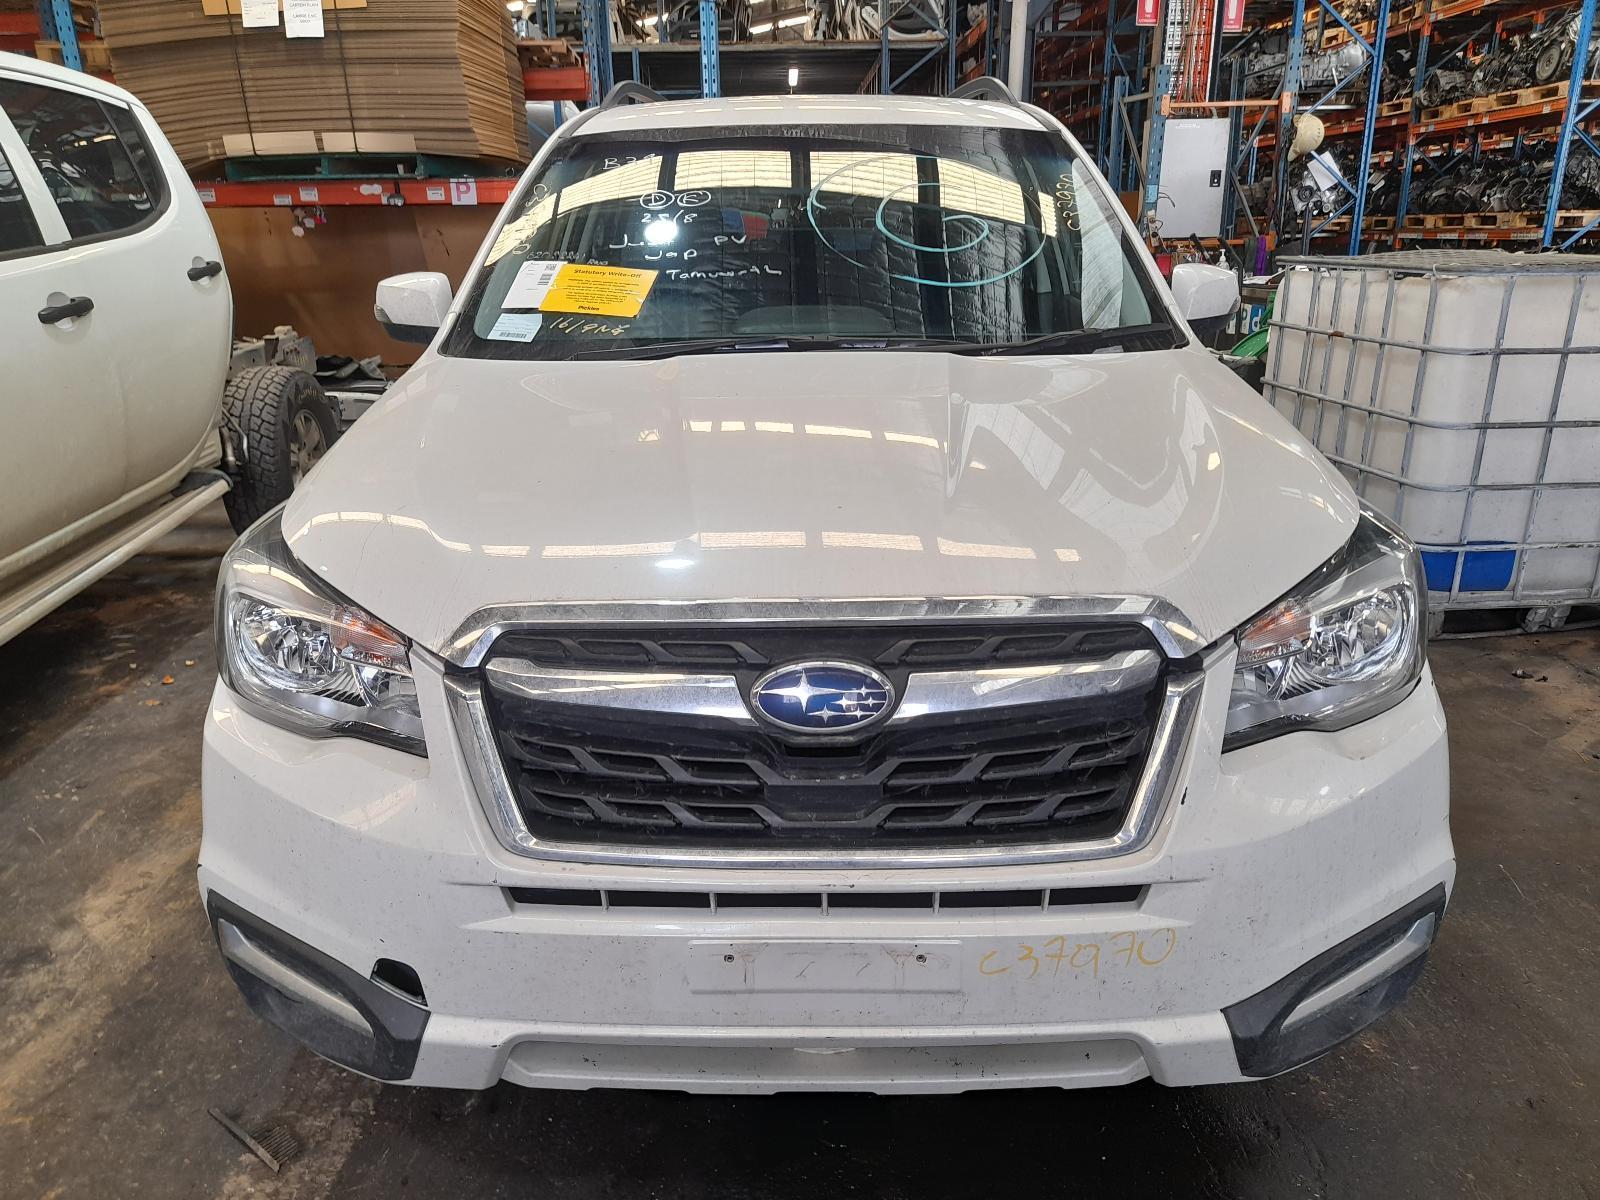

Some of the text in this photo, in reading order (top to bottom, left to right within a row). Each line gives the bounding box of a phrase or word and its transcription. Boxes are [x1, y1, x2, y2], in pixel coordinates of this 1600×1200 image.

[455, 183, 471, 202] P
[574, 268, 607, 277] Statutory
[979, 927, 1177, 980] C37970
